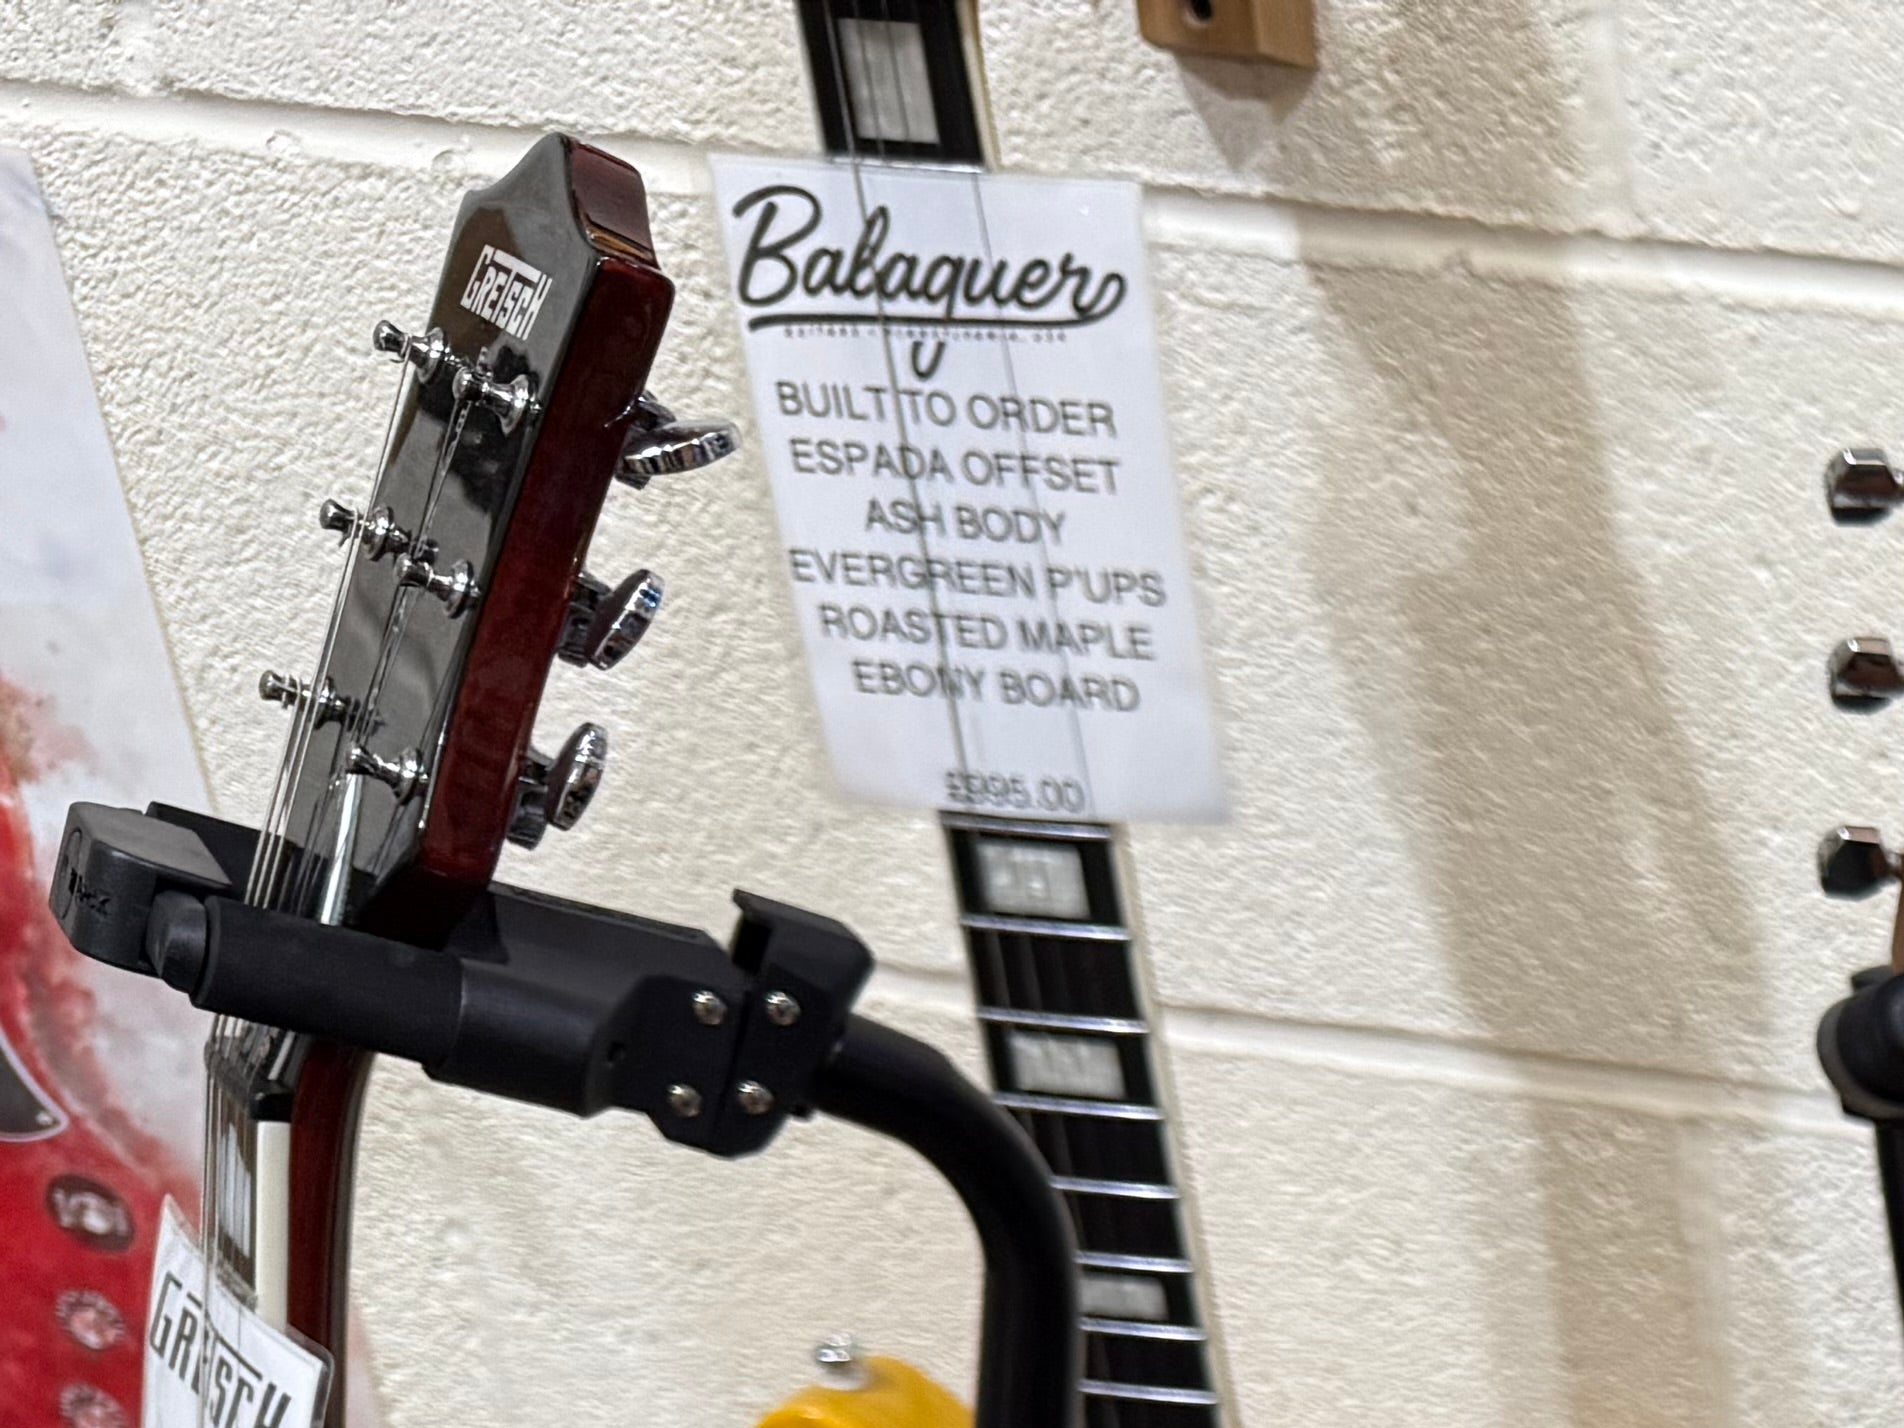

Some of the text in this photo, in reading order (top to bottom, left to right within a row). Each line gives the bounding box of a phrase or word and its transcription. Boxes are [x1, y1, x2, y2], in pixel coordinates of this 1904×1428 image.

[460, 244, 552, 340] GRETSCH
[732, 184, 1128, 379] Balaguer
[774, 381, 1116, 438] BUILT TO ORDER
[790, 439, 1120, 496] ESPADA OFFSET
[865, 498, 1065, 545] ASH BODY
[789, 548, 1035, 599] EVERGREEN
[818, 603, 1156, 660] ROASTED MAPLE
[852, 660, 1139, 712] EBONY BOARD
